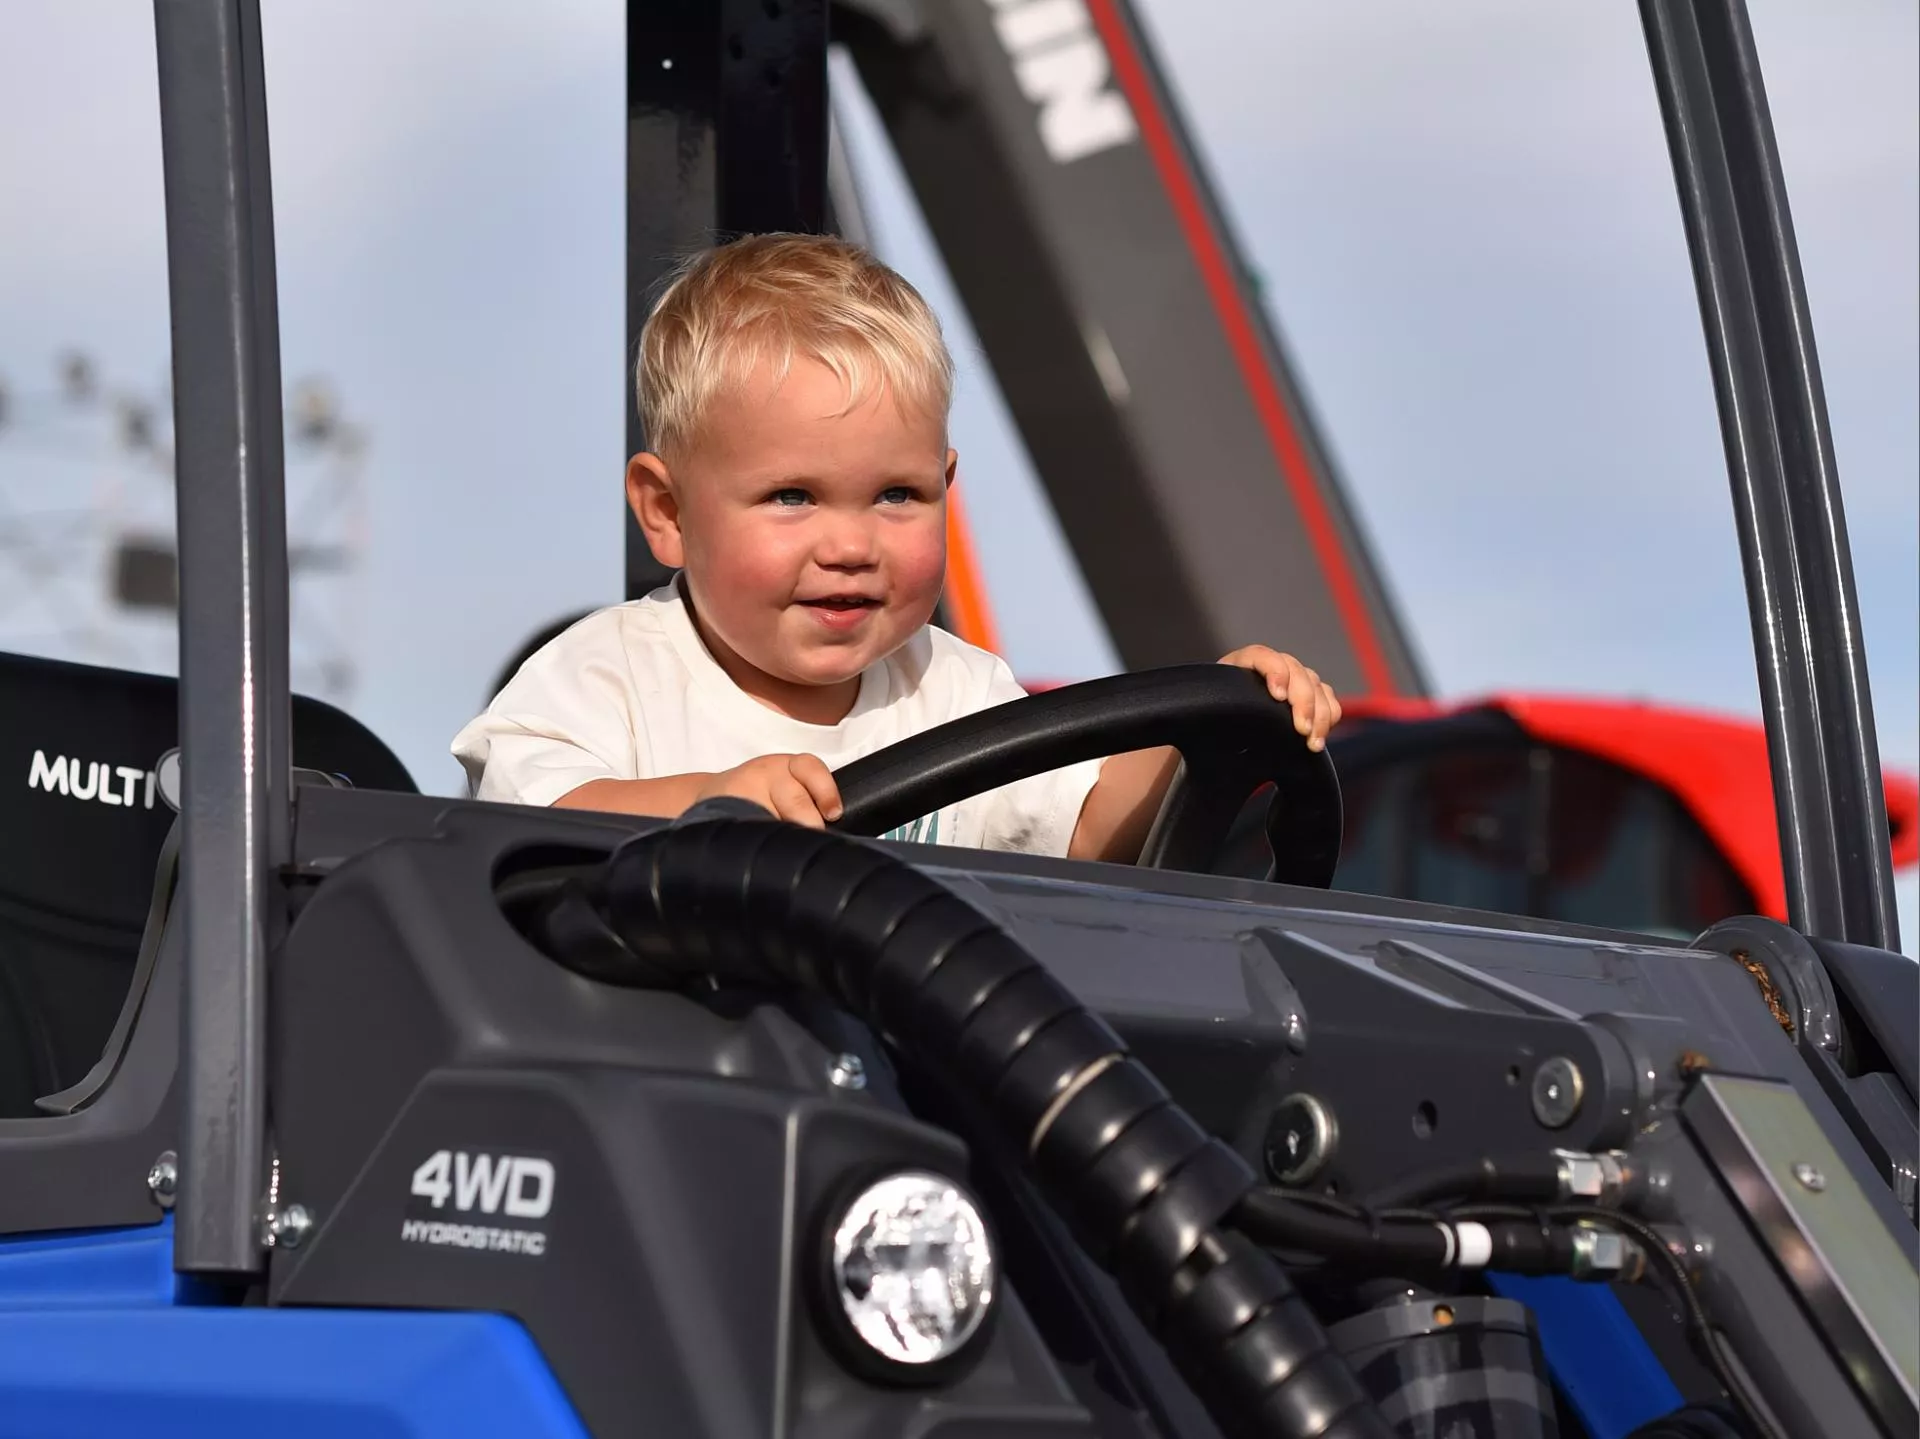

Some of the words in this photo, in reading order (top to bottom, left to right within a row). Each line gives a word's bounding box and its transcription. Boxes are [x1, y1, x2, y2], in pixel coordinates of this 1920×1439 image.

[28, 749, 156, 810] MULTI
[411, 1150, 556, 1219] 4WD
[401, 1219, 547, 1256] HYDROSTATIC
